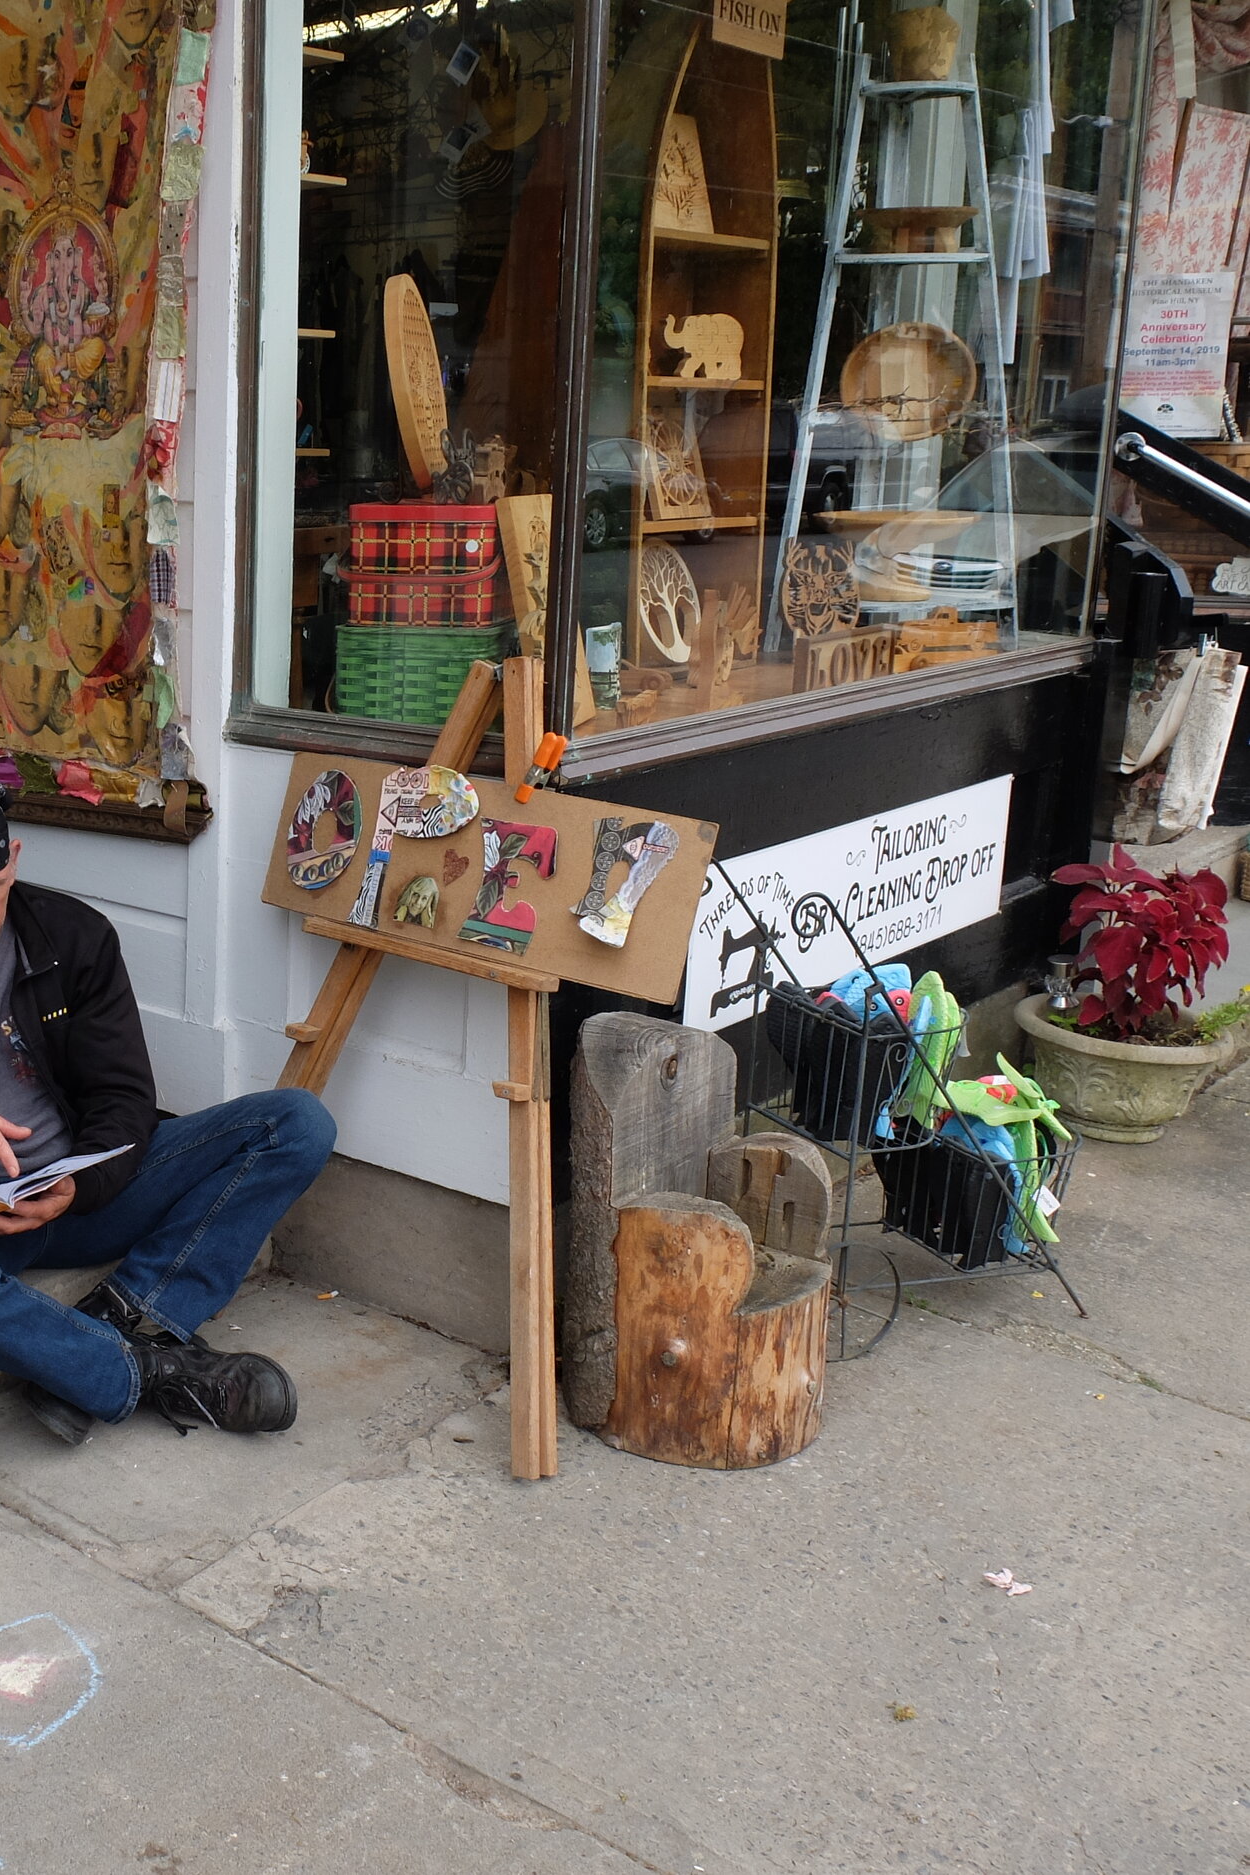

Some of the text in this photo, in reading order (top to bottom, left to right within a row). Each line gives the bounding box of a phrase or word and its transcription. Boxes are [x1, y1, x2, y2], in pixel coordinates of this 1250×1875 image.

[719, 0, 781, 36] FISH ON
[1160, 310, 1189, 319] 30TH
[1140, 322, 1207, 333] Anniversary
[1141, 334, 1204, 344] Celebration
[1122, 347, 1176, 357] September
[1196, 346, 1221, 354] 2019
[1145, 358, 1196, 368] 11am-3pm
[809, 636, 892, 692] LOVE
[871, 814, 947, 875] TAILORING
[757, 874, 772, 896] OF
[773, 871, 796, 915] TIME
[844, 869, 922, 933] CLEANING
[924, 856, 968, 904] DROP
[971, 842, 997, 878] OFF
